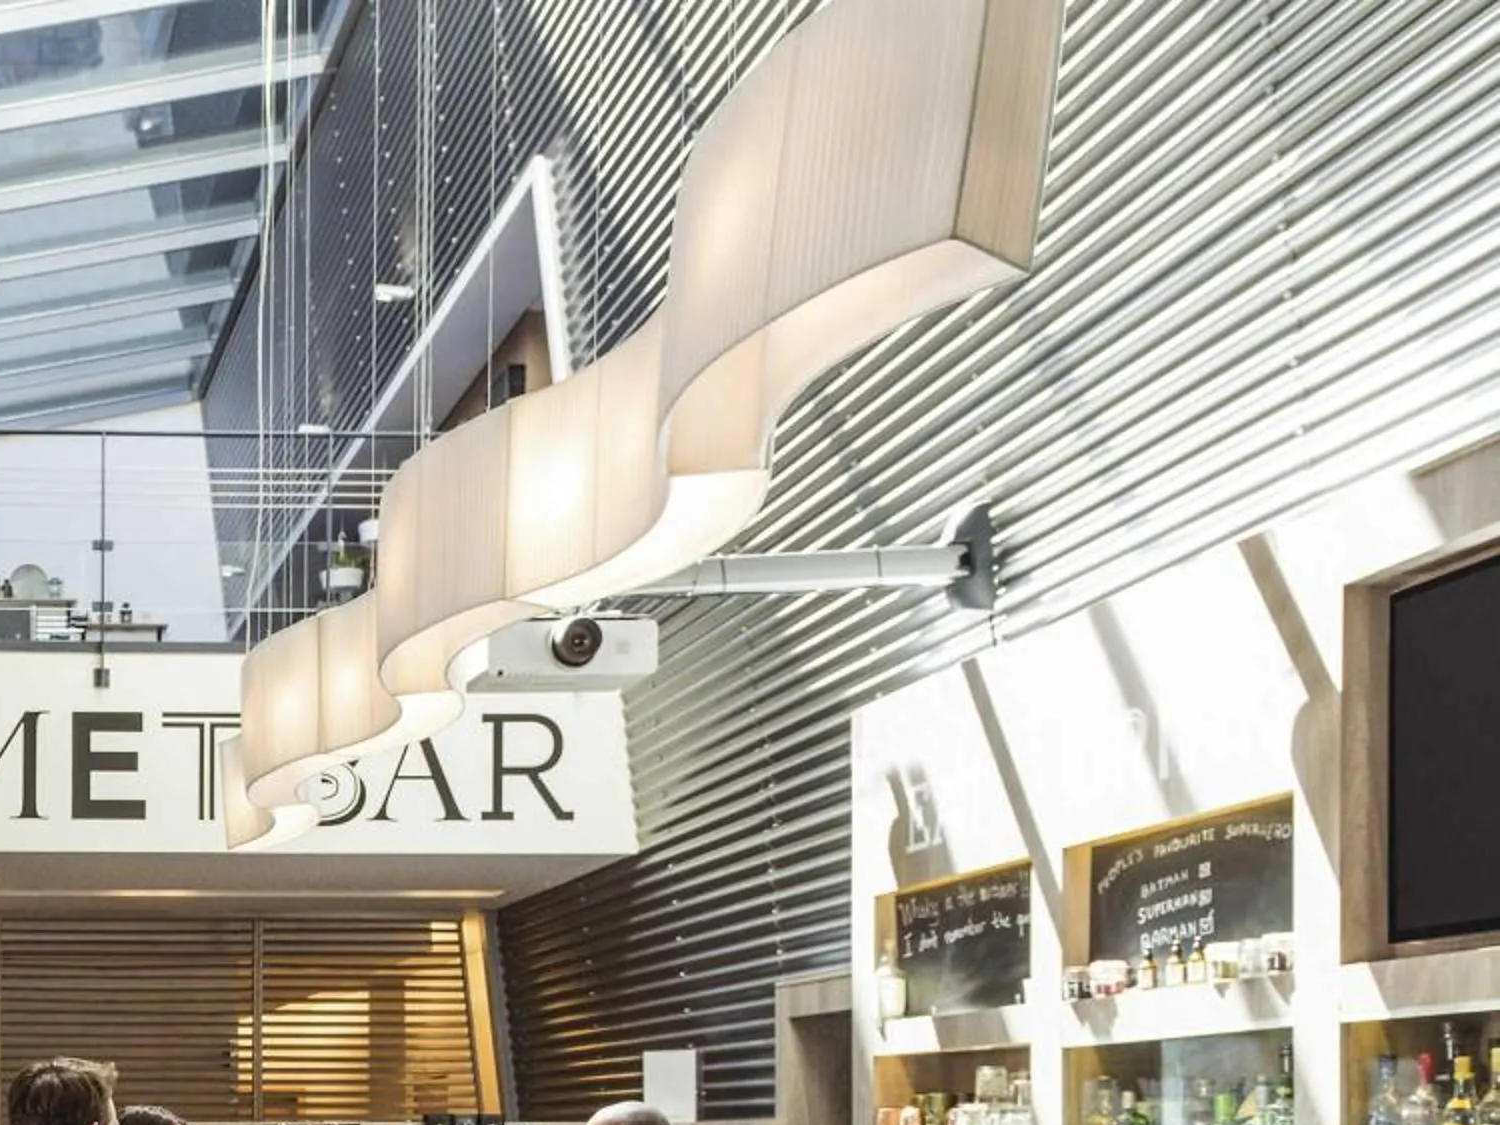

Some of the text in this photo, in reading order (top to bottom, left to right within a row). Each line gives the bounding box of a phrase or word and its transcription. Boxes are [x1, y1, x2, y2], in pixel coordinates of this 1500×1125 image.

[314, 712, 575, 827] AR
[1140, 868, 1190, 899] BATMAN
[1137, 892, 1199, 925] SUPERMAN
[1140, 919, 1197, 951] BARMAN
